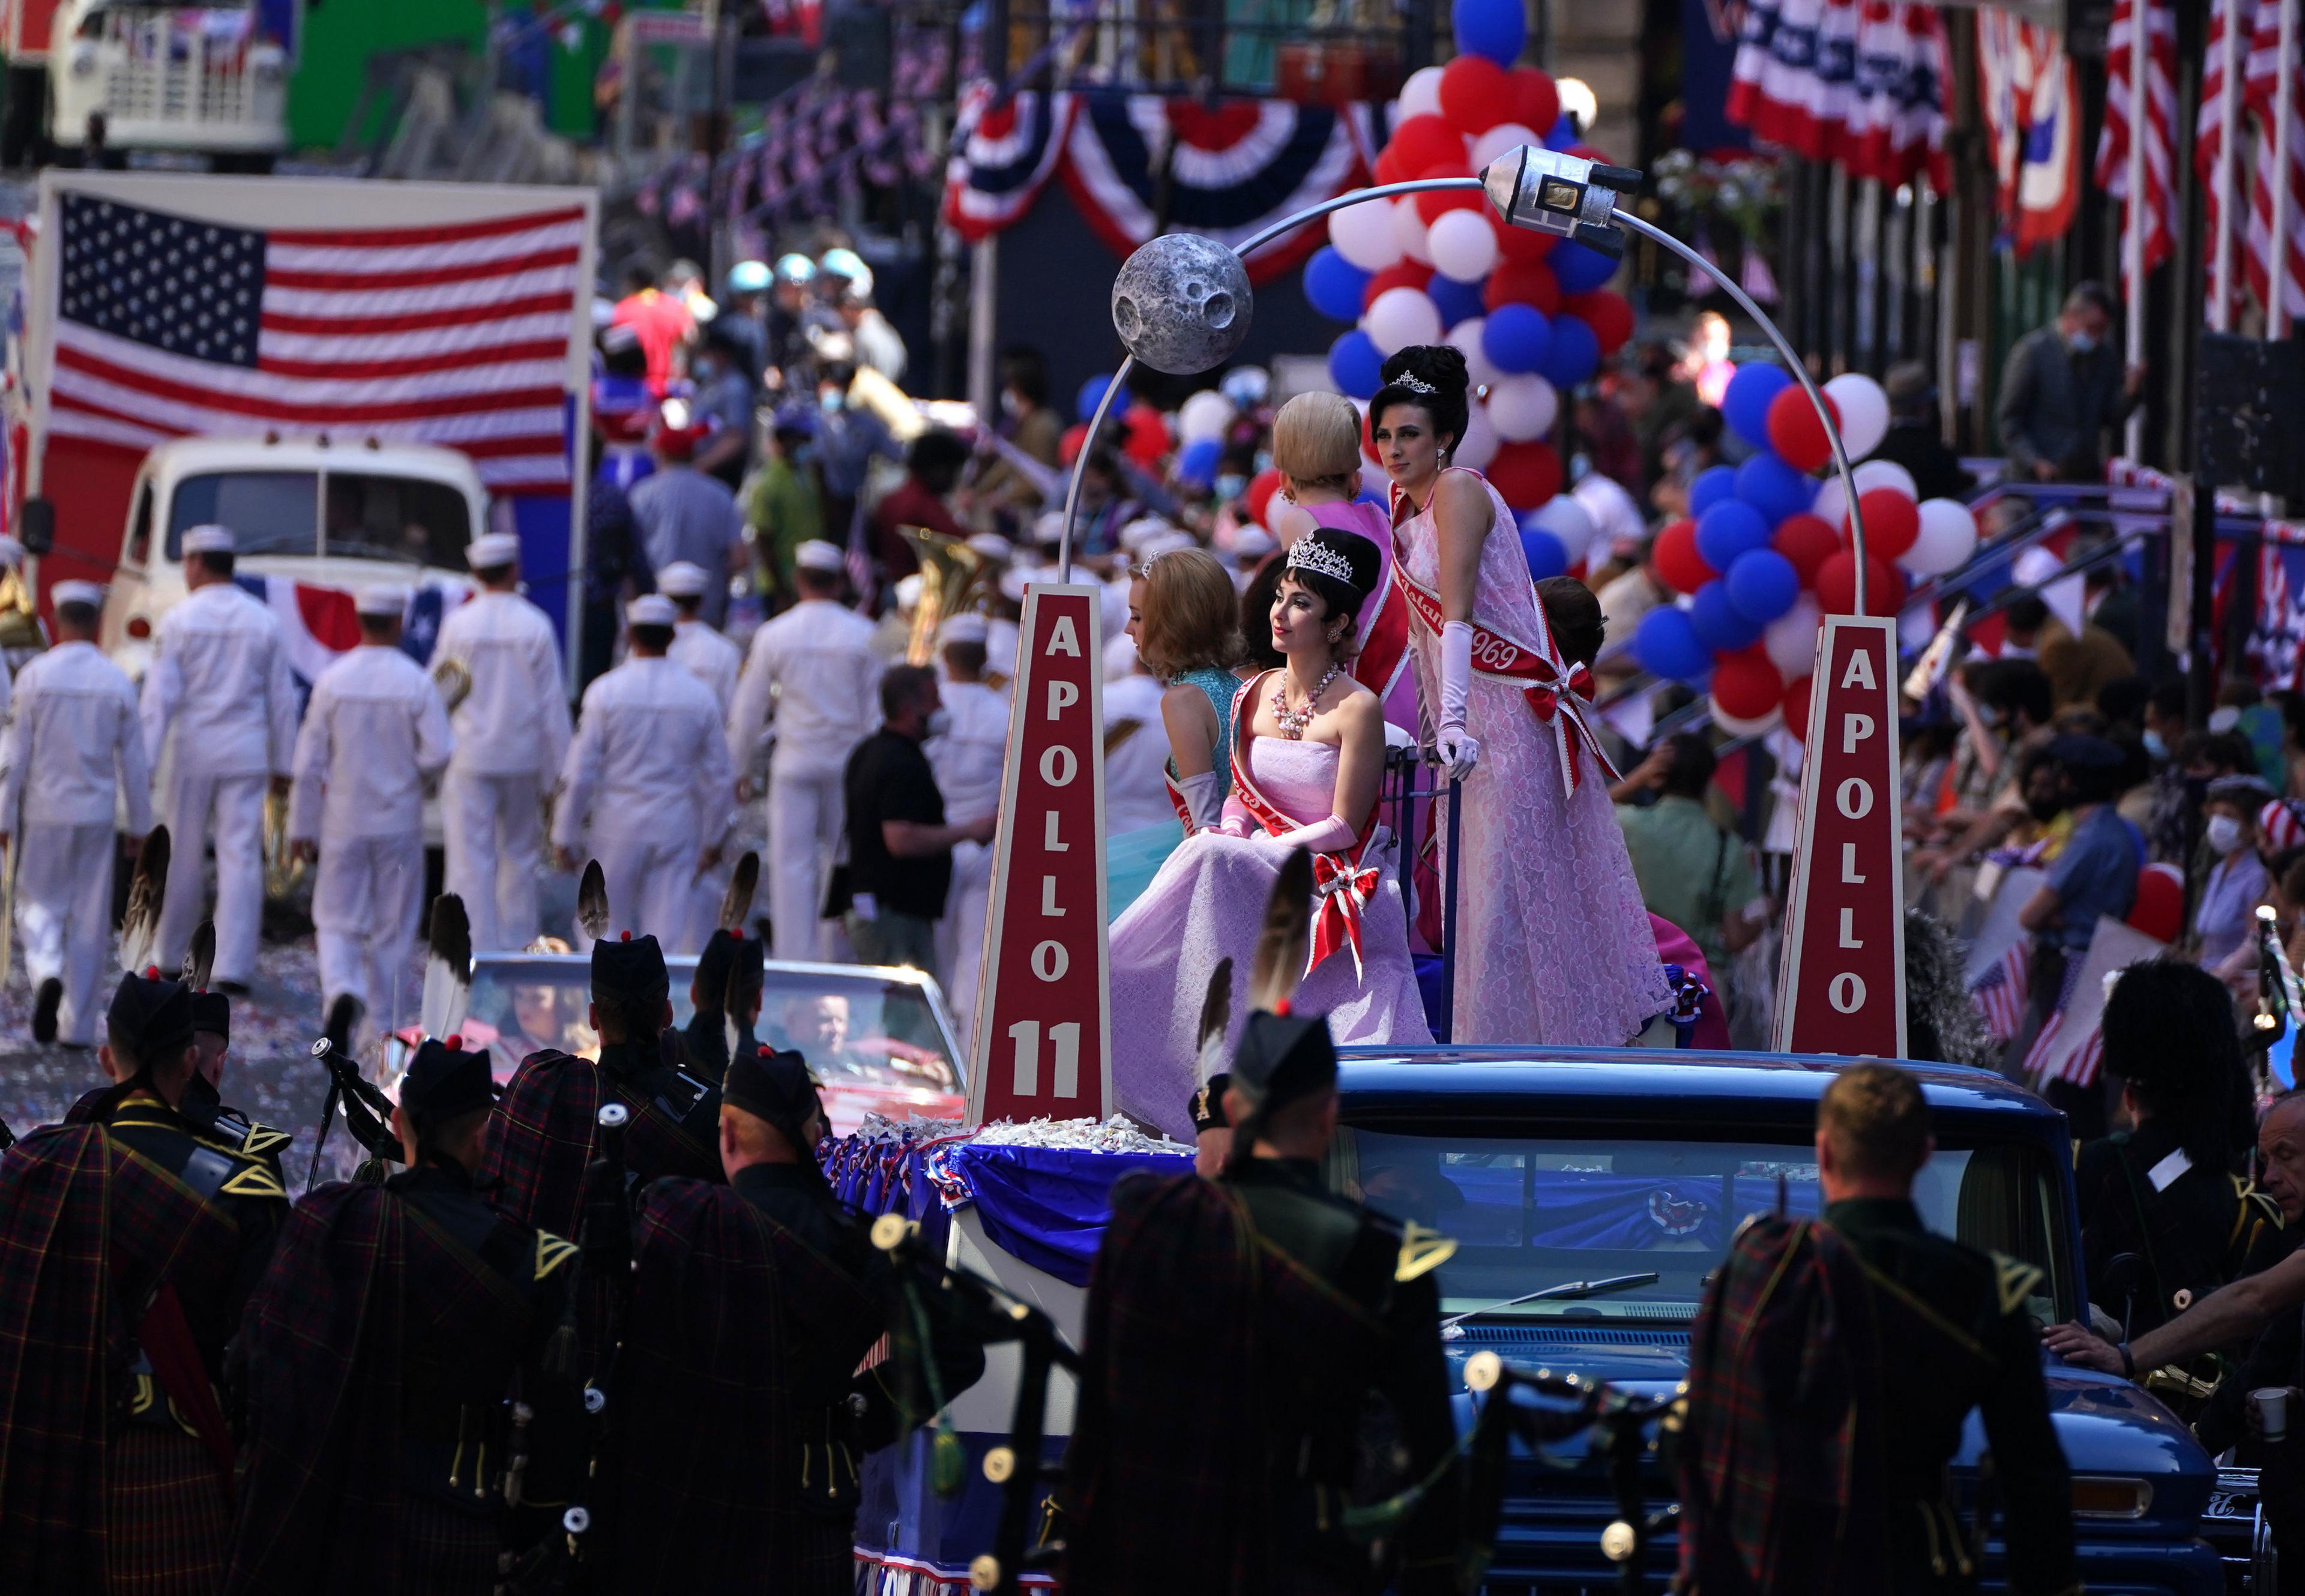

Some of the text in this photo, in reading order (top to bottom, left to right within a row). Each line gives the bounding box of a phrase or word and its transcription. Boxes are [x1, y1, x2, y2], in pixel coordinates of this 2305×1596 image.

[1400, 578, 1518, 670] Islan 969
[1031, 615, 1081, 983] APOLLO
[1828, 648, 1877, 1014] APOLLO
[1008, 1020, 1081, 1099] 11
